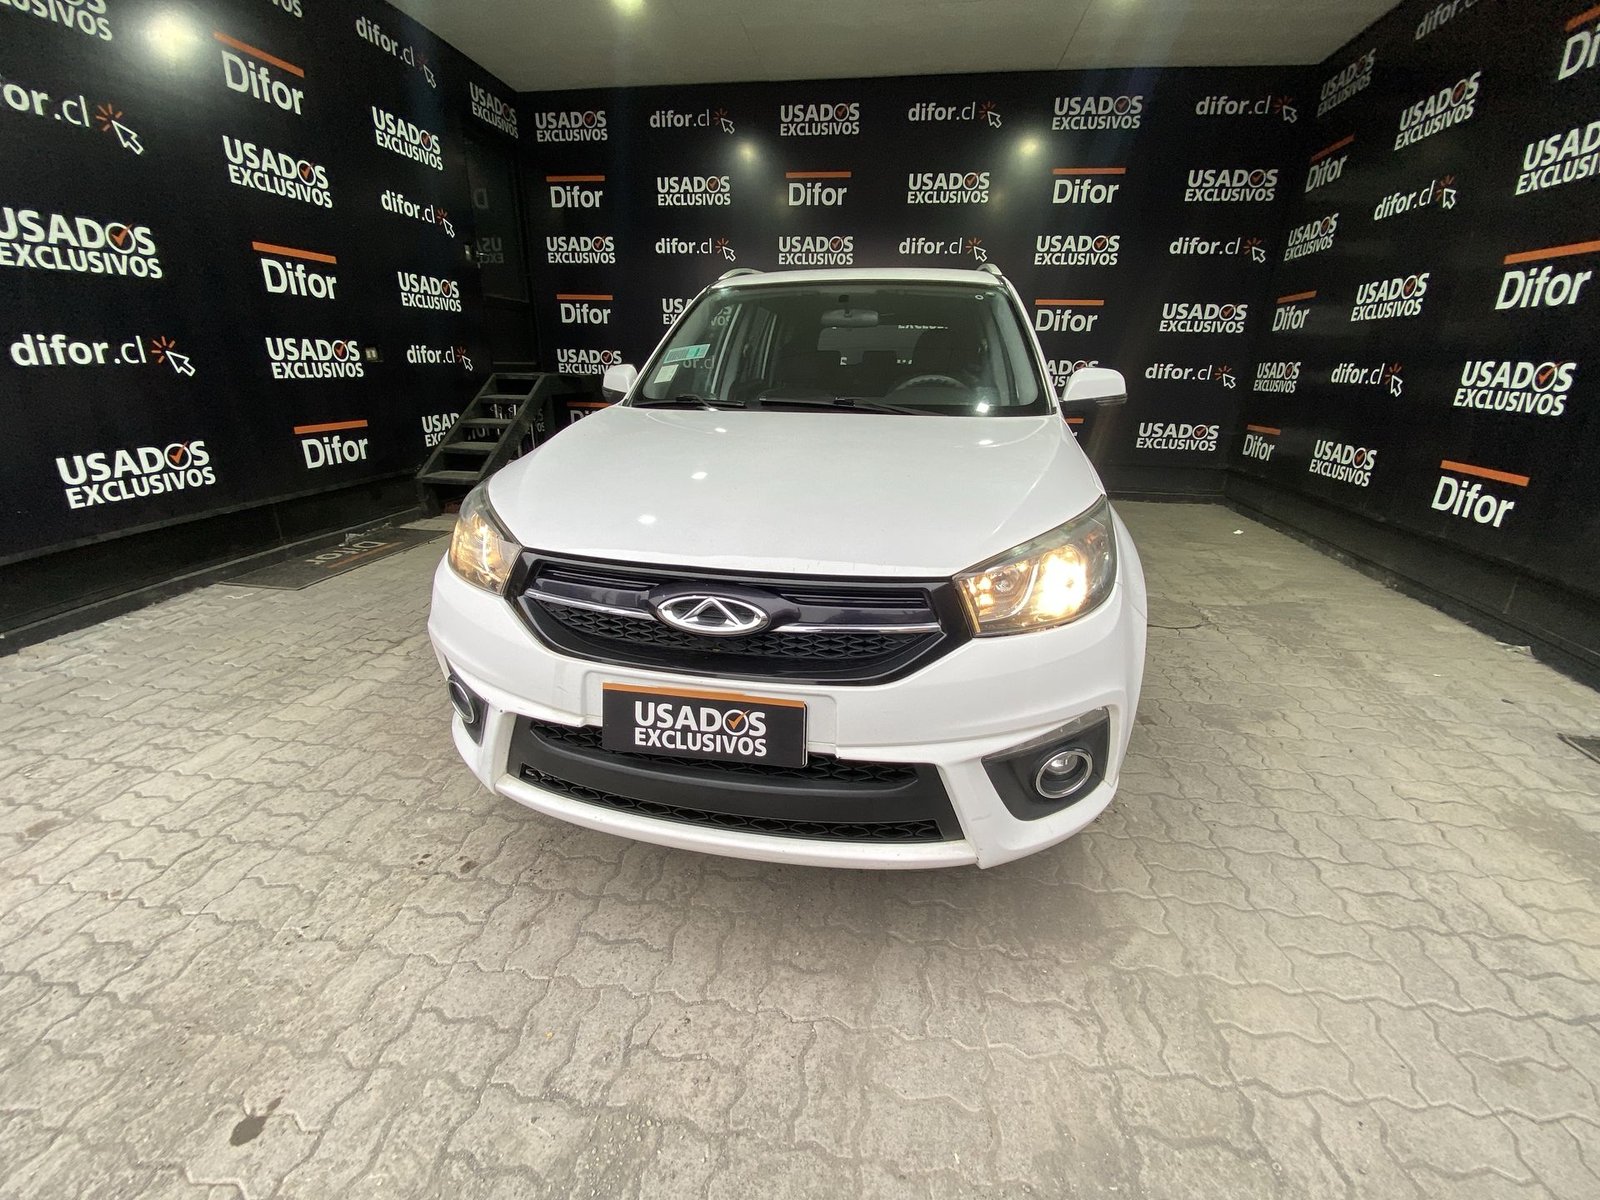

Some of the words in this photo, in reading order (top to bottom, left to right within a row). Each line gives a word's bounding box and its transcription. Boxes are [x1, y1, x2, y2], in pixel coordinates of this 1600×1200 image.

[356, 16, 415, 67] difor.cl
[222, 50, 304, 116] Difor
[1320, 48, 1376, 100] USADOS
[469, 81, 517, 125] USADOS
[1054, 95, 1143, 116] USADOS
[1195, 95, 1271, 116] difor.cl
[1317, 71, 1371, 118] EXCLUSIVOS
[1400, 71, 1481, 131] USADOS
[471, 101, 519, 139] EXCLUSIVOS
[535, 110, 607, 129] USADOS
[650, 109, 710, 128] difor.cl
[780, 103, 859, 122] USADOS
[908, 102, 975, 121] difor.cl
[1052, 115, 1141, 130] EXCLUSIVOS
[371, 106, 441, 154] USADOS
[536, 128, 608, 142] EXCLUSIVOS
[780, 122, 859, 136] EXCLUSIVOS
[1394, 99, 1475, 151] EXCLUSIVOS
[375, 129, 443, 171] EXCLUSIVOS
[222, 135, 329, 190] USADOS
[1305, 154, 1347, 193] Difor
[1515, 153, 1600, 195] EXCLUSI
[228, 164, 333, 209] EXCLUSIVOS
[657, 176, 730, 193] USADOS
[908, 172, 990, 190] USADOS
[1188, 169, 1278, 188] USADOS
[550, 186, 603, 208] Difor
[657, 193, 731, 206] EXCLUSIVOS
[788, 182, 847, 206] Difor
[907, 190, 989, 204] EXCLUSIVOS
[1052, 178, 1119, 204] Difor
[1185, 188, 1275, 202] EXCLUSIVOS
[1374, 180, 1435, 221] difor.cl
[381, 189, 435, 224] difor.cl
[1288, 213, 1339, 246] USADOS
[546, 236, 614, 251] USADOS
[655, 237, 712, 254] difor.cl
[778, 236, 853, 253] USADOS
[899, 237, 963, 255] difor.cl
[1036, 235, 1120, 252] USADOS
[1169, 237, 1241, 255] difor.cl
[1283, 233, 1333, 262] EXCLUSIVOS
[548, 252, 615, 264] EXCLUSIVOS
[778, 253, 853, 265] EXCLUSIVOS
[1034, 253, 1118, 266] EXCLUSIVOS
[260, 258, 337, 300] Difor
[397, 271, 460, 299] USADOS
[1356, 273, 1430, 305] USADOS
[1495, 266, 1592, 310] Difor
[401, 291, 461, 312] EXCLUSIVOS
[1162, 303, 1248, 321] USADOS
[1350, 298, 1423, 322] EXCLUSIVOS
[560, 303, 611, 324] Difor
[1035, 309, 1098, 332] Difor
[1272, 307, 1309, 332] Difor
[1159, 321, 1245, 334] EXCLUSIVOS
[10, 334, 147, 367] difor.cl
[265, 337, 360, 362] USADOS
[407, 344, 454, 363] difor.cl
[556, 348, 621, 364] USADOS
[271, 361, 364, 379] EXCLUSIVOS
[1145, 364, 1212, 381] difor.cl
[1257, 362, 1301, 380] USADOS
[1331, 363, 1385, 385] difor.cl
[1460, 361, 1576, 393] USADOS
[1253, 379, 1297, 393] EXCLUSIVOS
[1453, 388, 1567, 416] EXCLUSIVOS
[1139, 423, 1219, 440] USADOS
[301, 435, 368, 469] Difor
[1136, 438, 1217, 451] EXCLUSIVOS
[1242, 434, 1275, 461] Difor
[1313, 440, 1378, 471] USADOS
[55, 440, 210, 486] USADOS
[1309, 460, 1371, 487] EXCLUSIVOS
[65, 466, 216, 510] EXCLUSIVOS
[1431, 476, 1515, 528] Difor
[634, 701, 767, 736] USADOS
[634, 728, 767, 757] EXCLUSIVOS
